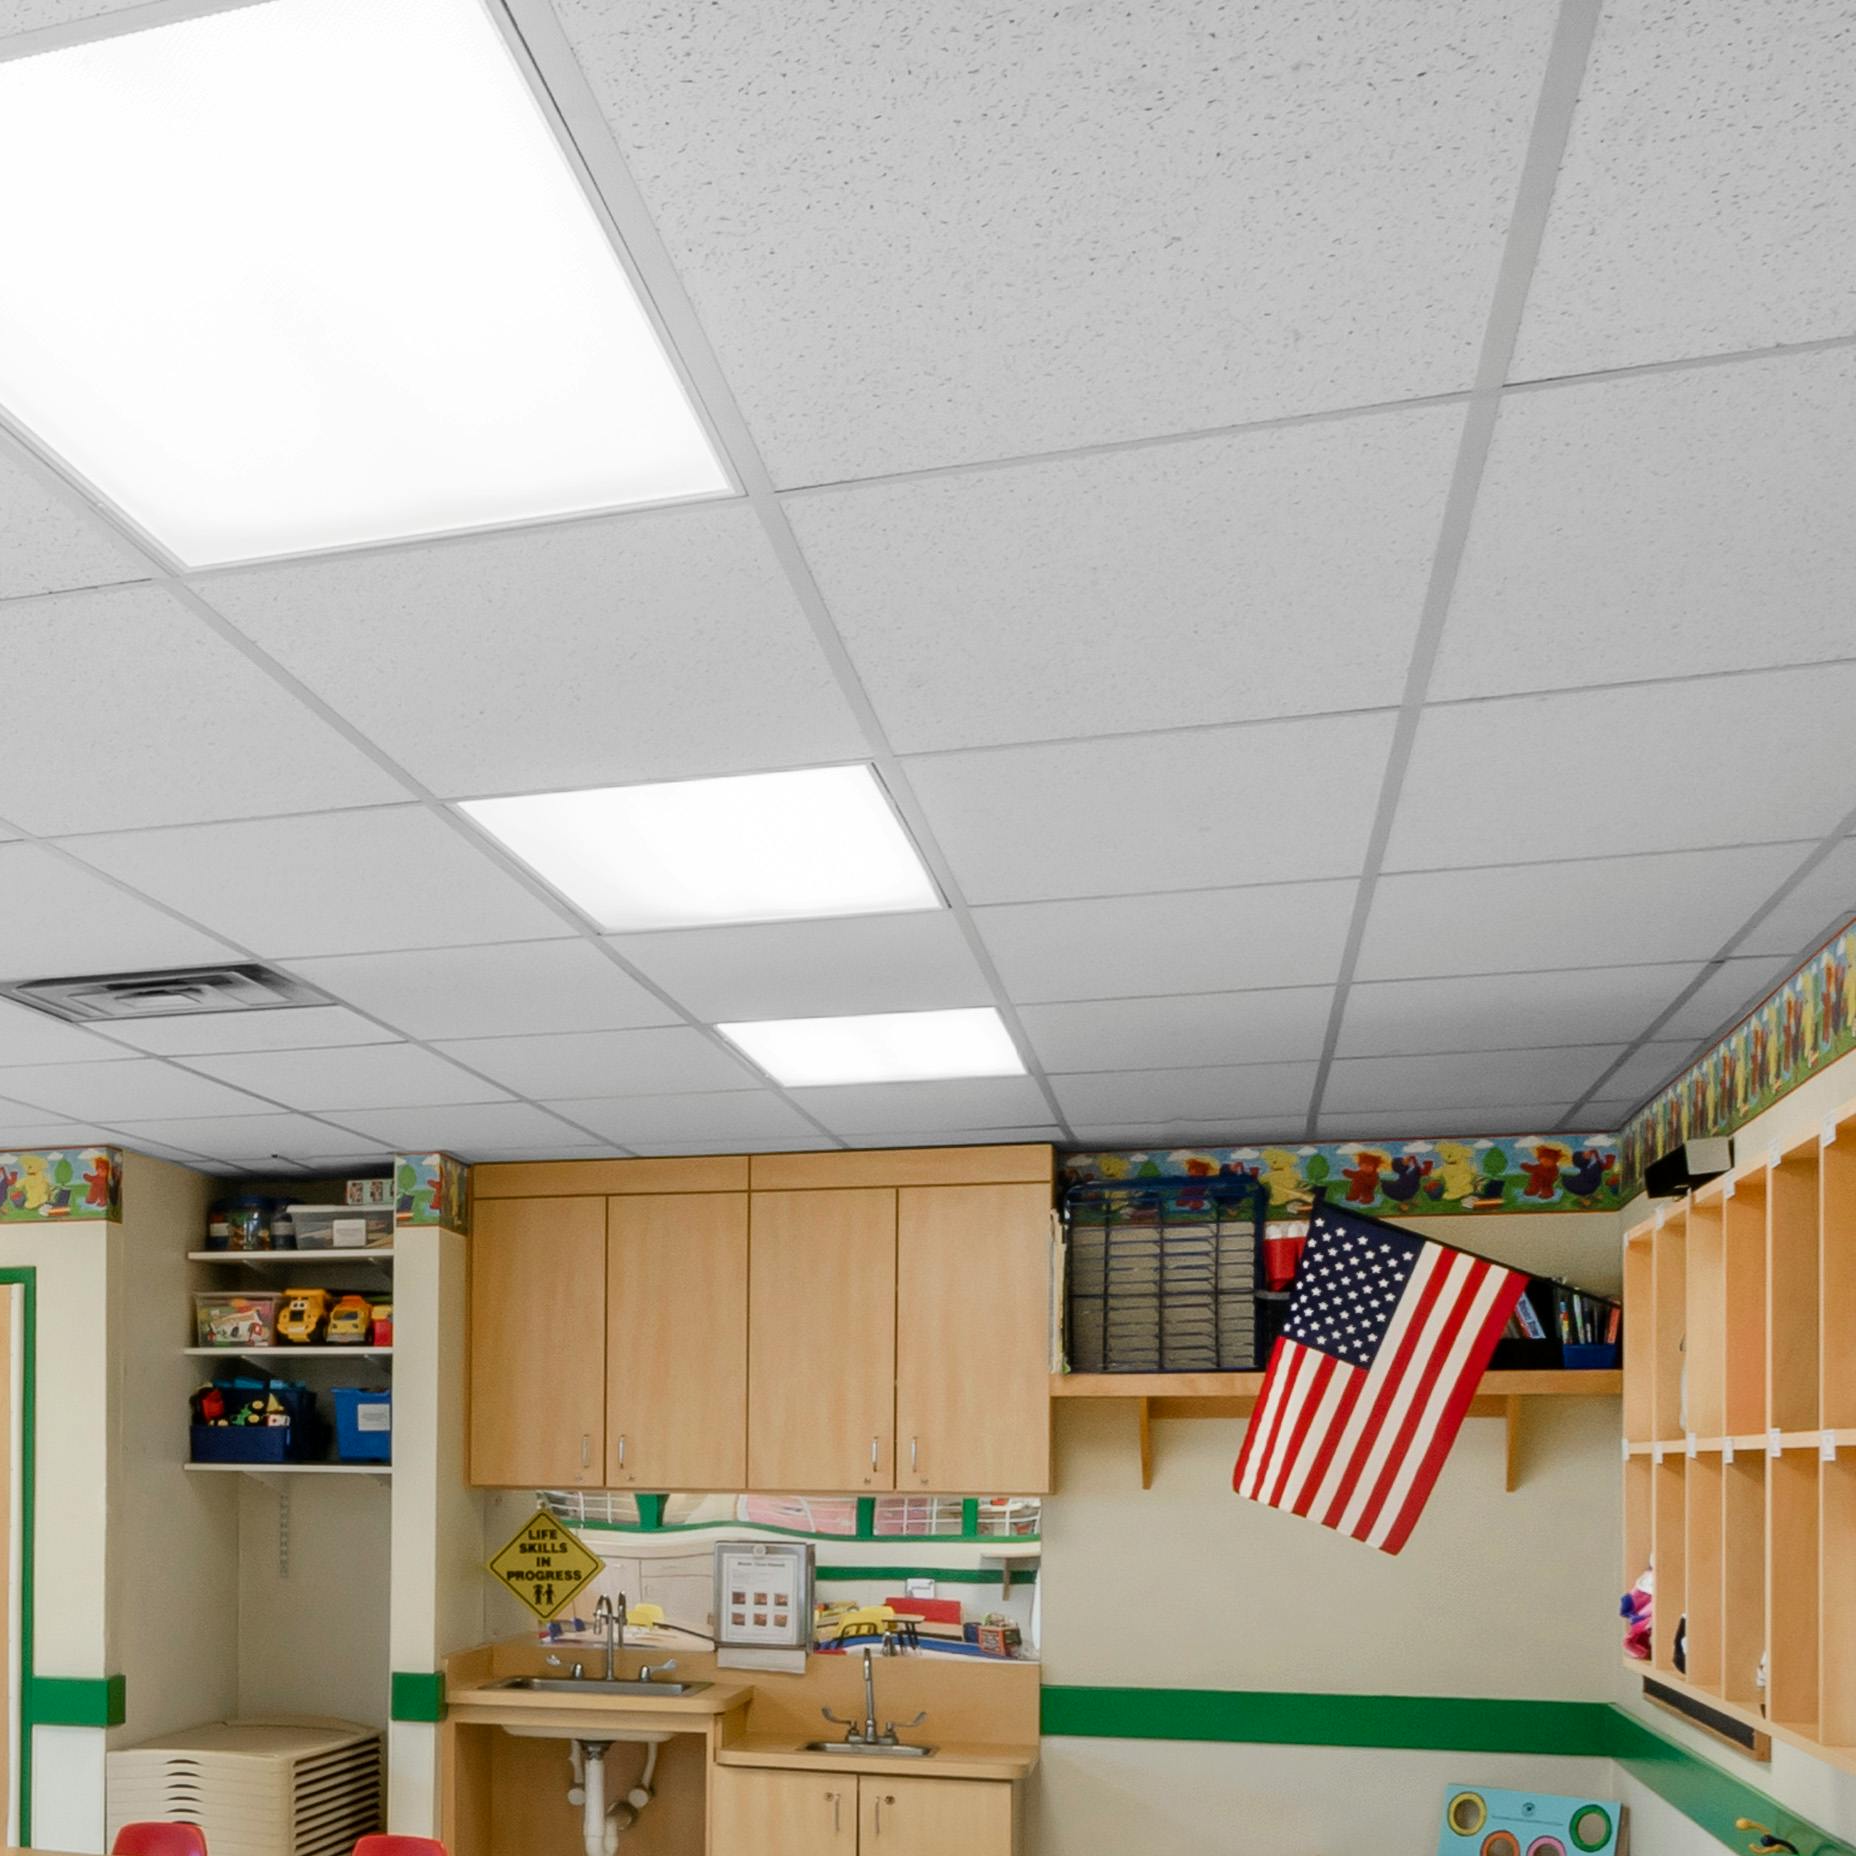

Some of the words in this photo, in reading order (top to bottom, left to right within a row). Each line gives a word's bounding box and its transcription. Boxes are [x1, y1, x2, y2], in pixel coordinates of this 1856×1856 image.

[528, 1529, 558, 1540] LIFE
[519, 1542, 568, 1554] SKILLS
[536, 1557, 551, 1567] IN
[506, 1570, 582, 1581] PROGRESS
